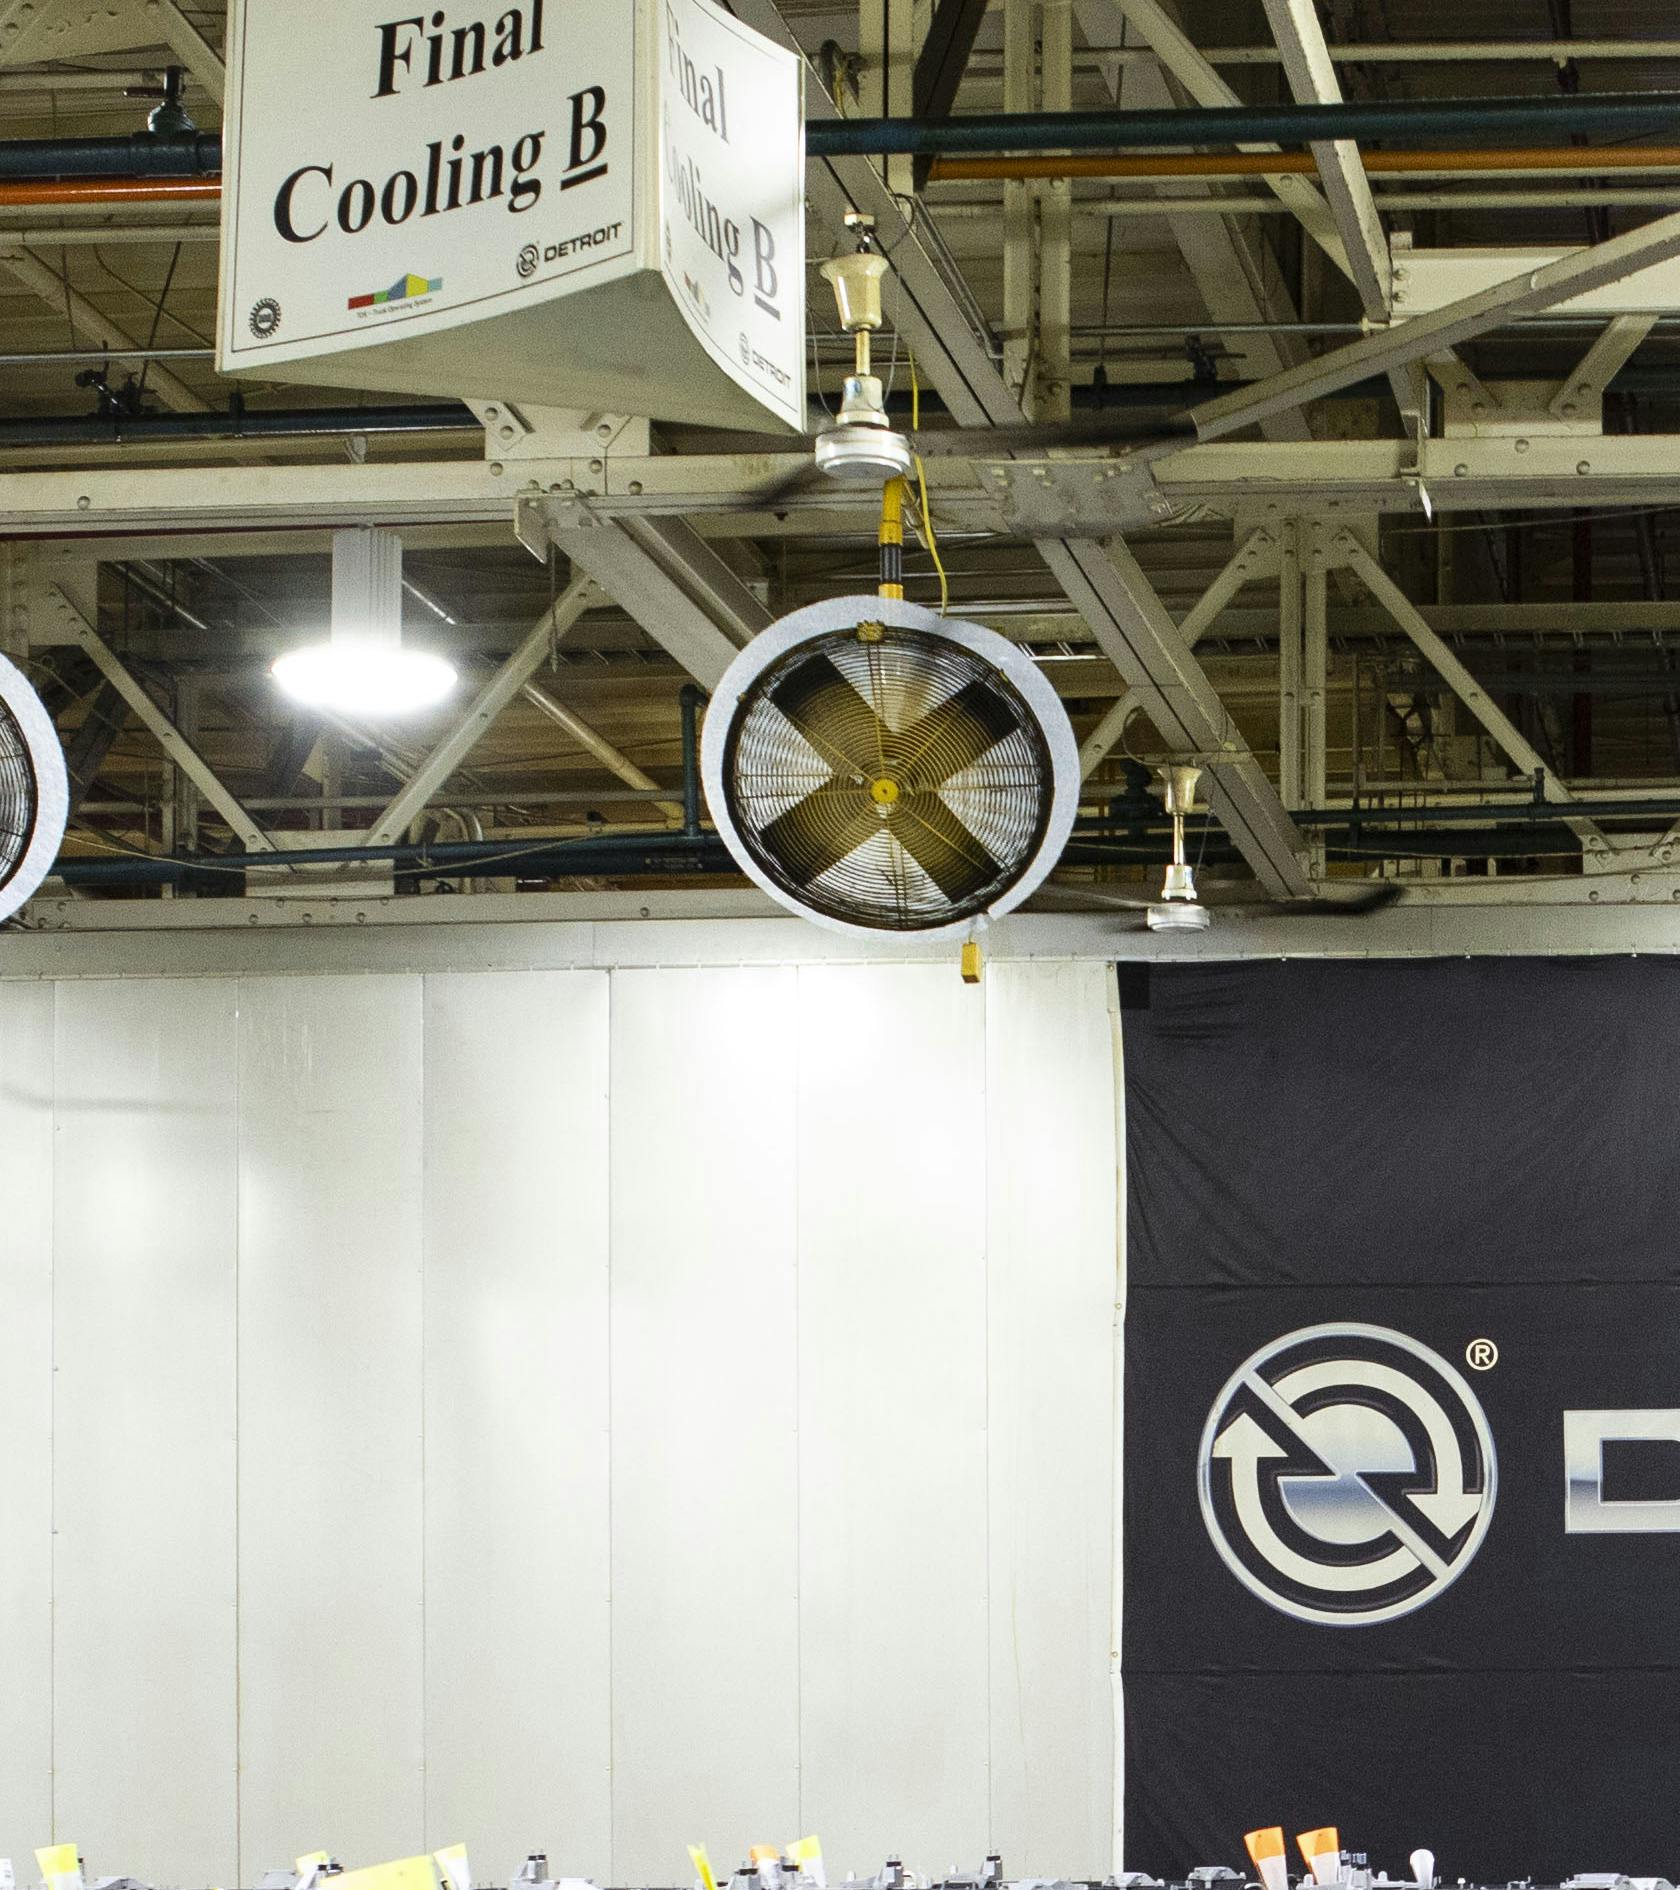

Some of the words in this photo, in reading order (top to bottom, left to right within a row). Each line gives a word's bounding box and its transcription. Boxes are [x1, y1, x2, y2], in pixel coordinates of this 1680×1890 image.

[370, 0, 545, 99] Final
[273, 134, 545, 243] Cooling
[561, 86, 608, 173] B
[544, 222, 622, 262] DETROIT
[749, 214, 781, 299] B
[752, 349, 791, 389] DETROIT
